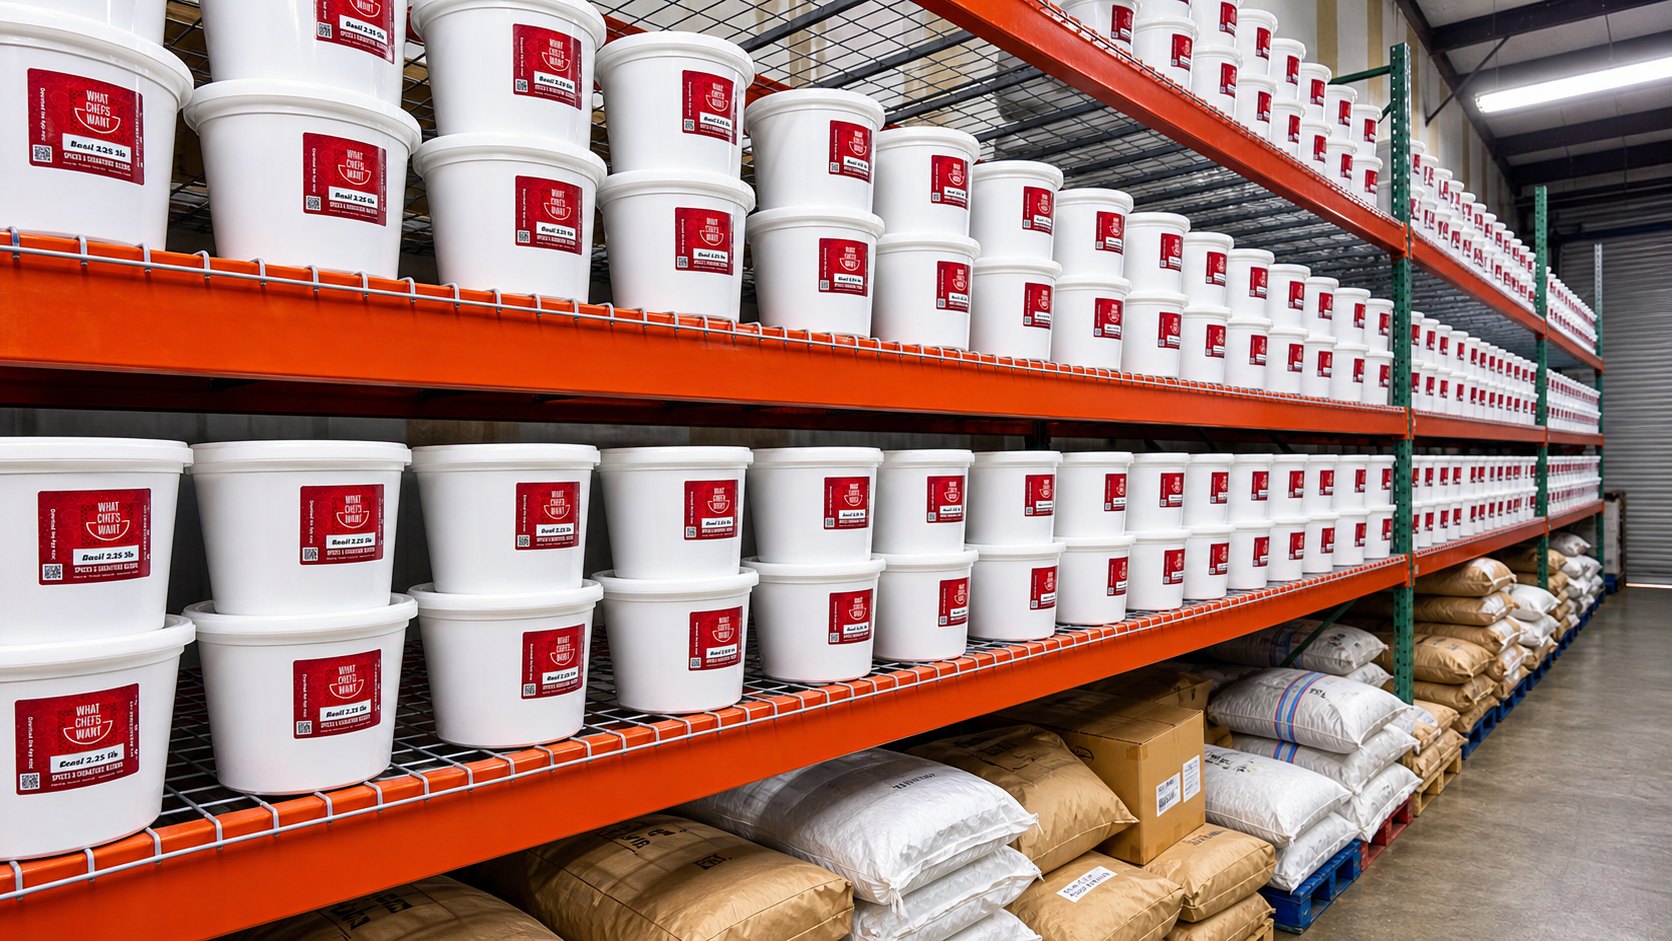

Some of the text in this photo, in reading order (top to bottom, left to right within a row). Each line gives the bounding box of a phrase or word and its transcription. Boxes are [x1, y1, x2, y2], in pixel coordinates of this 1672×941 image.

[86, 90, 109, 104] WHAT
[98, 502, 119, 512] WHAT
[76, 703, 100, 717] WHAT
[75, 726, 101, 740] WANT
